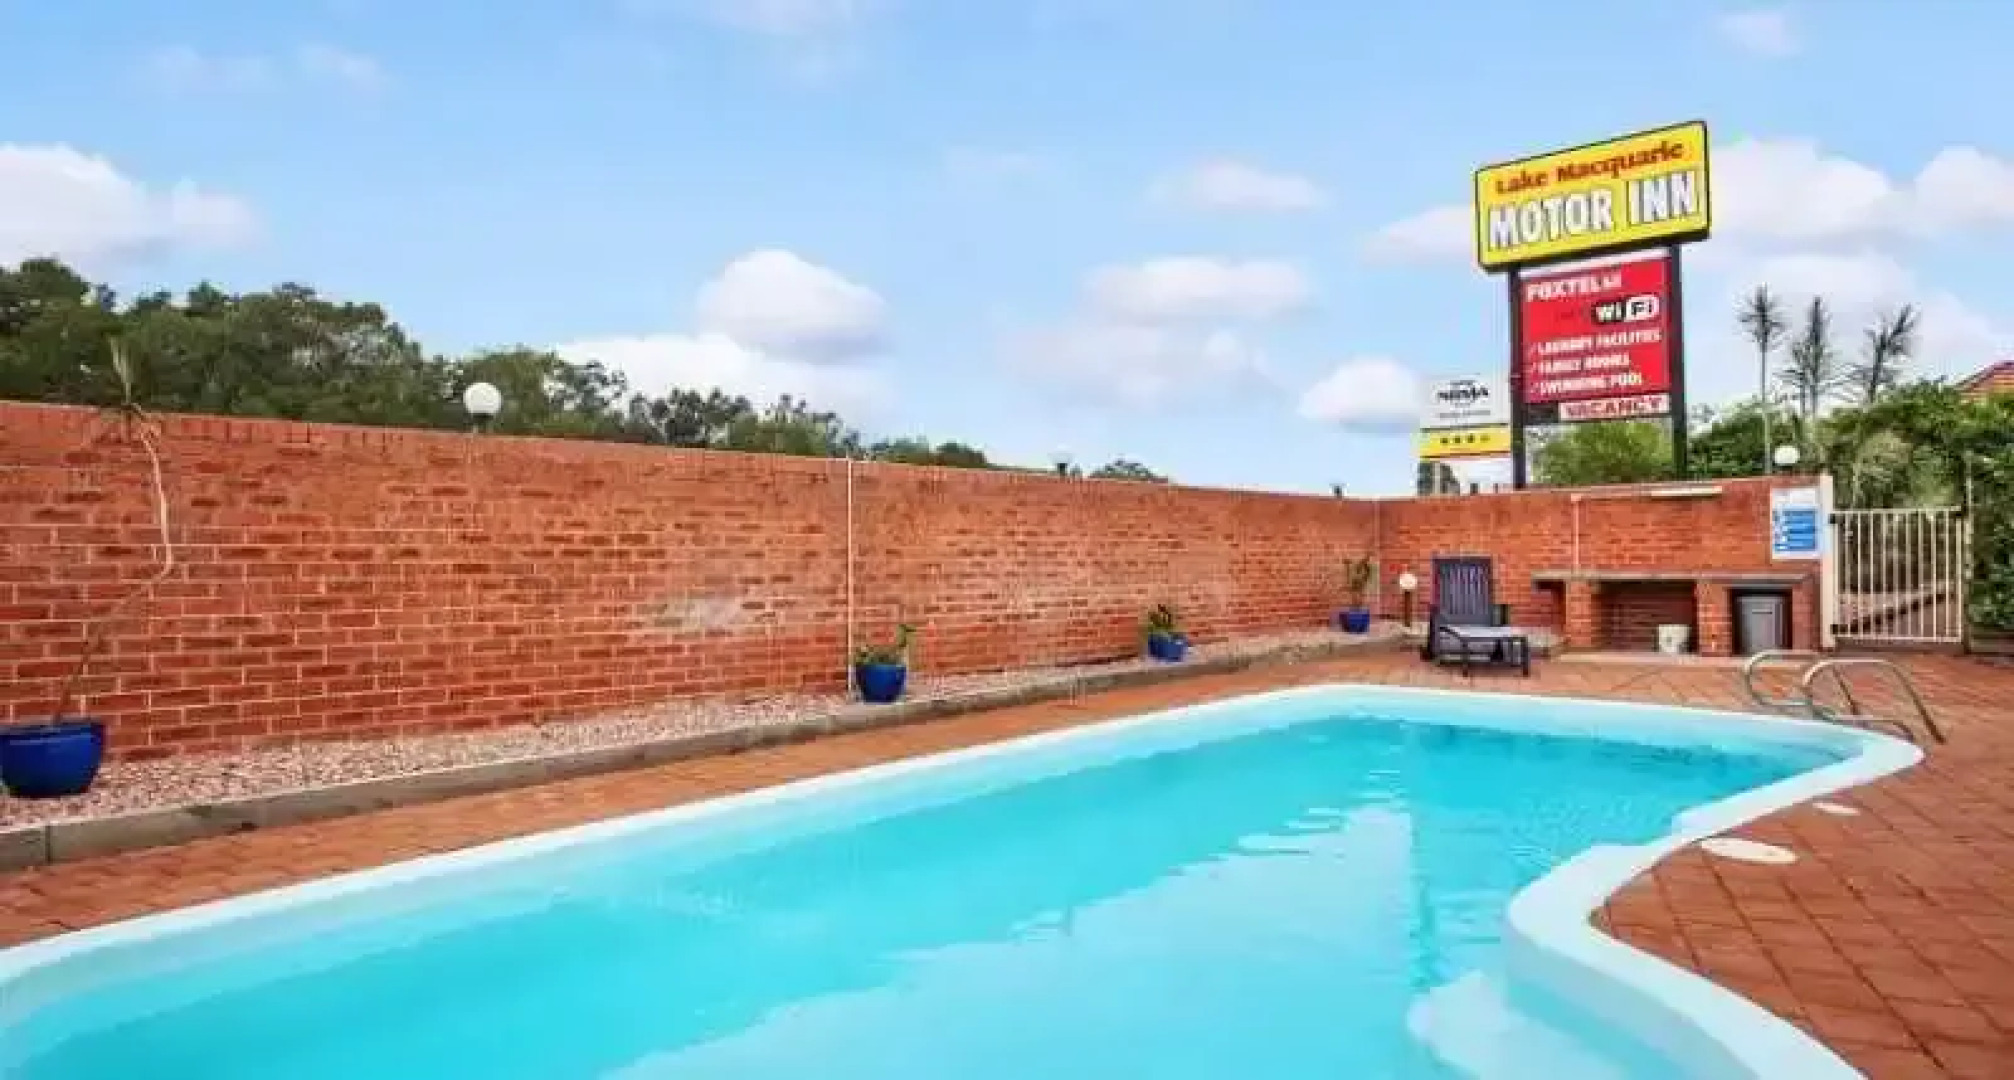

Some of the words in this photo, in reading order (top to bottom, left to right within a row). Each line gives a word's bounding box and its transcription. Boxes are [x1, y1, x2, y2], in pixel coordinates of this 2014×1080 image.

[1496, 170, 1548, 193] Lake
[1557, 141, 1683, 179] Macquarie
[1489, 189, 1612, 249] MOTOR
[1627, 171, 1697, 226] INN
[1527, 275, 1602, 302] FOXTEL
[1566, 394, 1665, 417] VACANCY
